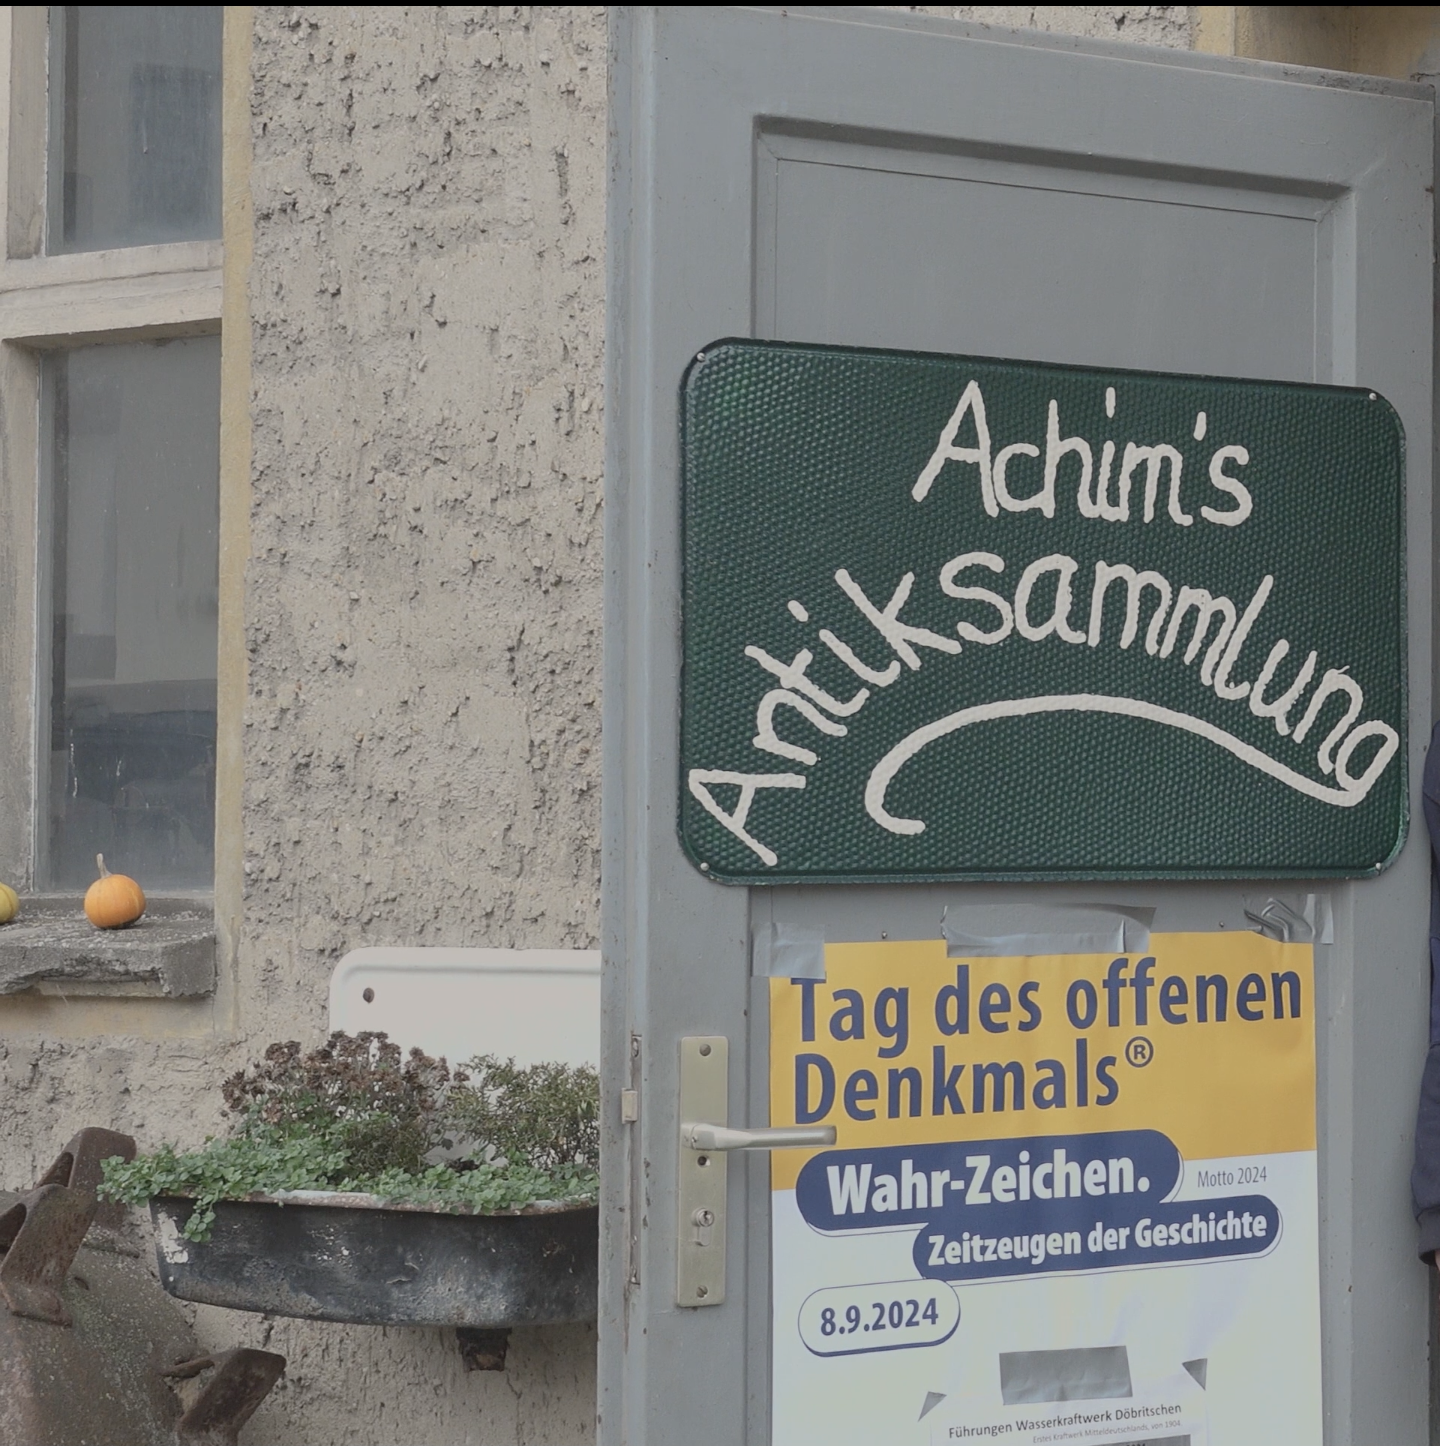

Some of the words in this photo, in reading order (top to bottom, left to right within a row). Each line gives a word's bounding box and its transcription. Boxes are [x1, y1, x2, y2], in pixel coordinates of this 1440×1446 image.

[911, 379, 1253, 527] Achim's
[687, 551, 1400, 866] Antiksammlung
[790, 976, 910, 1058] Tag
[934, 964, 1042, 1036] des
[1066, 956, 1302, 1031] offenen
[826, 1149, 1151, 1216] Wahr-Zeichen.
[1197, 1170, 1234, 1188] Motto
[1237, 1166, 1267, 1185] 2024
[927, 1226, 1082, 1266] Zeitzeugen
[1088, 1221, 1131, 1254] der
[1134, 1209, 1268, 1248] Geschichte
[819, 1297, 940, 1337] 8.9.2024
[949, 1422, 1012, 1439] Führungen
[1016, 1410, 1113, 1431] Wasserkraftwerk
[1115, 1404, 1182, 1420] Döbritschen
[1033, 1433, 1052, 1444] Erstes
[1053, 1430, 1084, 1442] Kraftwerk
[1151, 1422, 1164, 1430] von
